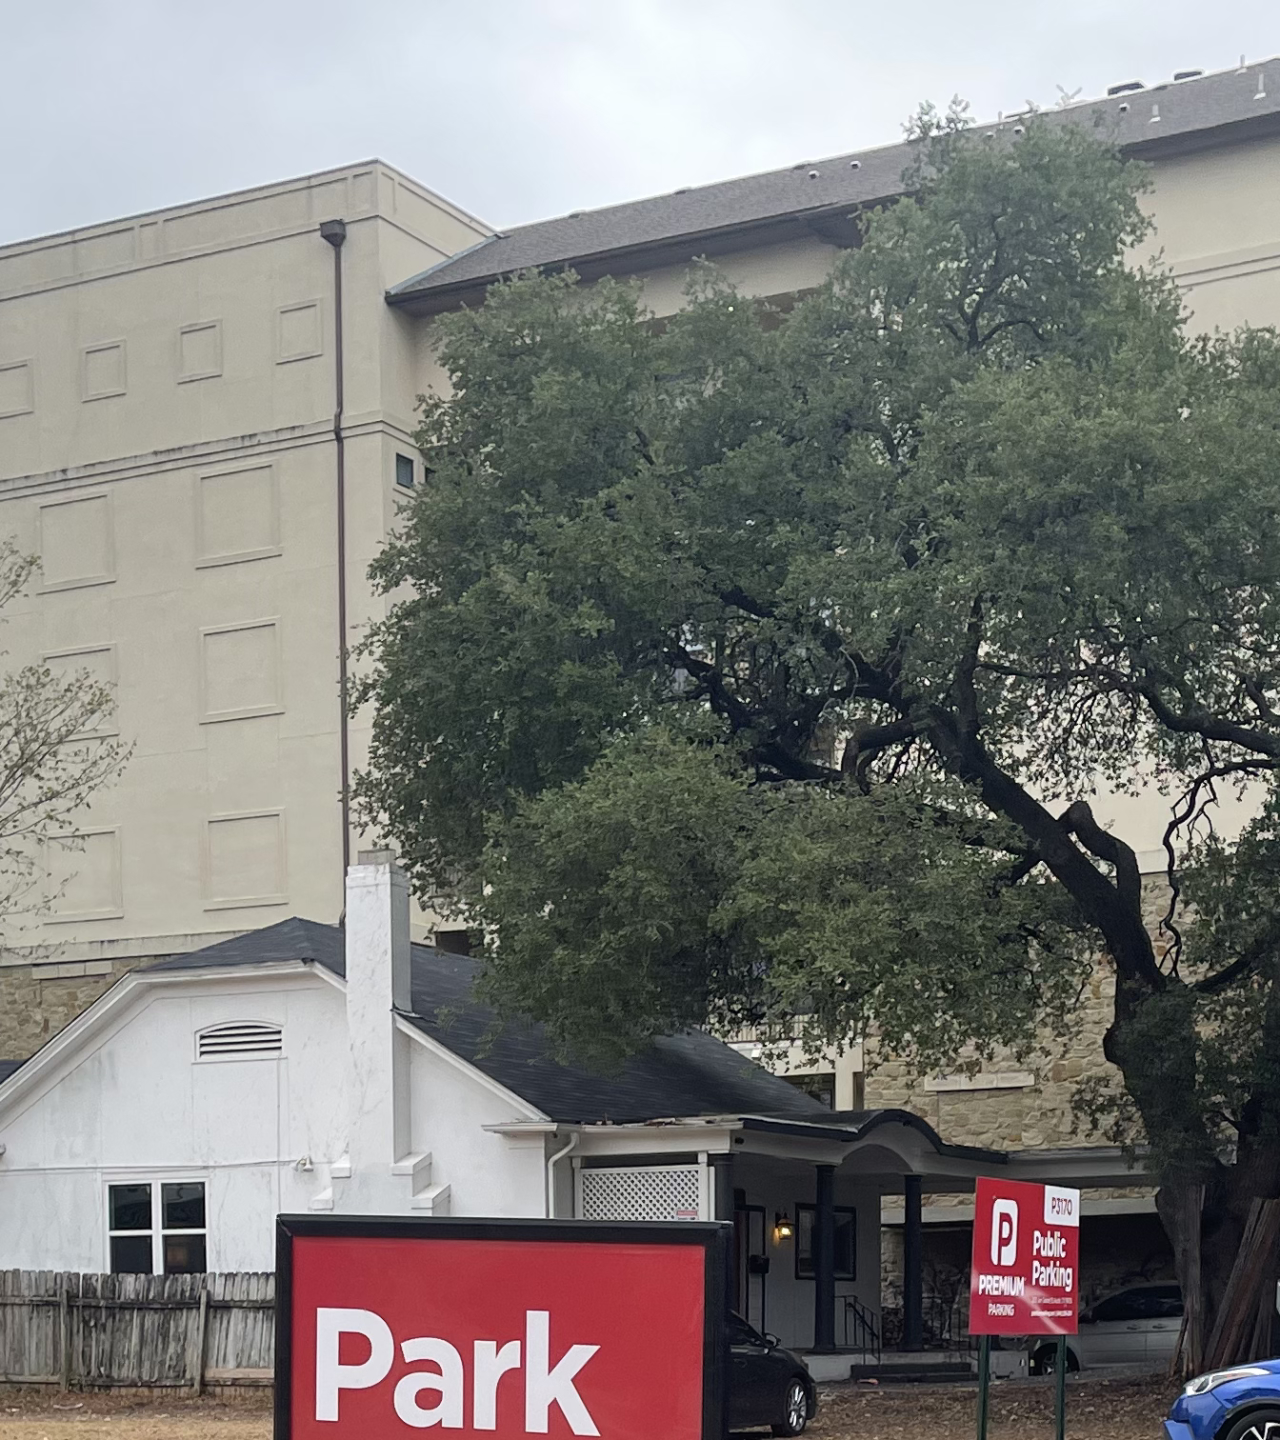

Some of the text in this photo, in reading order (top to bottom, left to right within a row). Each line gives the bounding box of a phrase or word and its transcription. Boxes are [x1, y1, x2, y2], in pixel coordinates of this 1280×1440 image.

[1033, 1230, 1067, 1258] Public
[978, 1274, 1025, 1297] PREMIUM
[1032, 1260, 1073, 1292] Parking
[987, 1303, 1015, 1317] PARKING
[315, 1307, 601, 1437] Park
